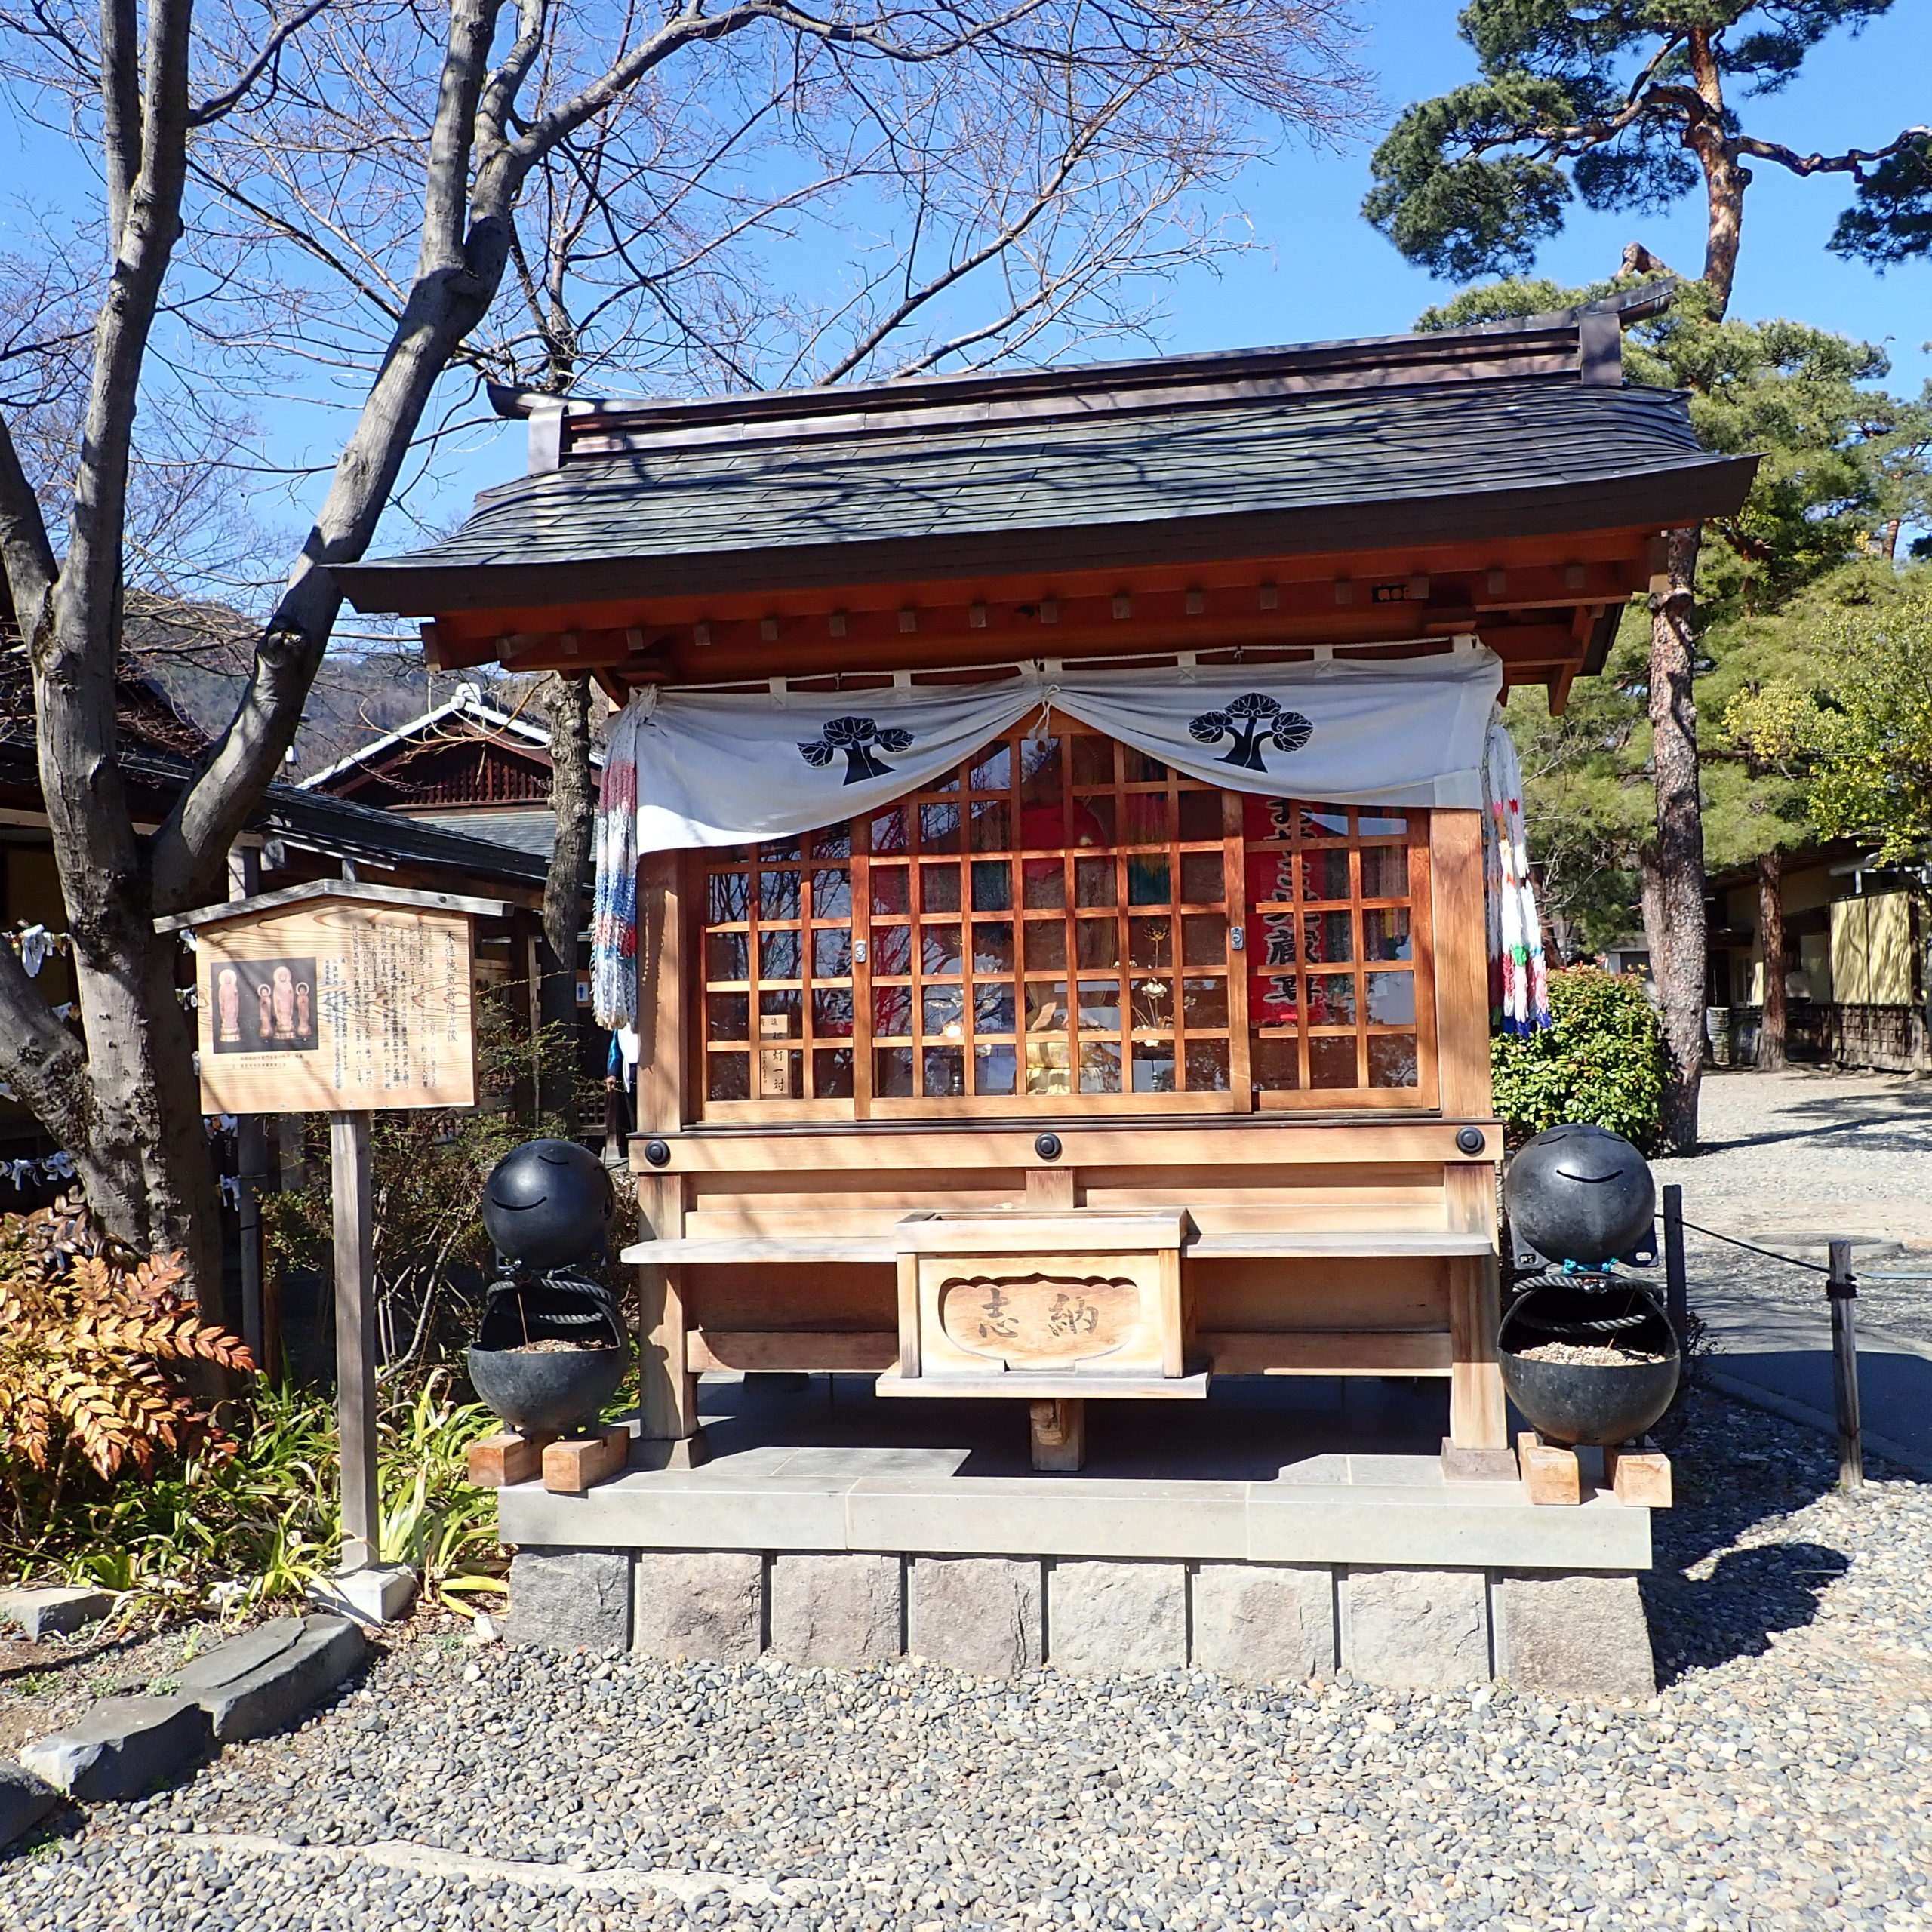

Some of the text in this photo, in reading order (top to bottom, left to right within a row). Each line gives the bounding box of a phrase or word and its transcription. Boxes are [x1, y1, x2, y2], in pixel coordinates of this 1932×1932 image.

[444, 930, 458, 1043] 木造地蔵菩薩立像
